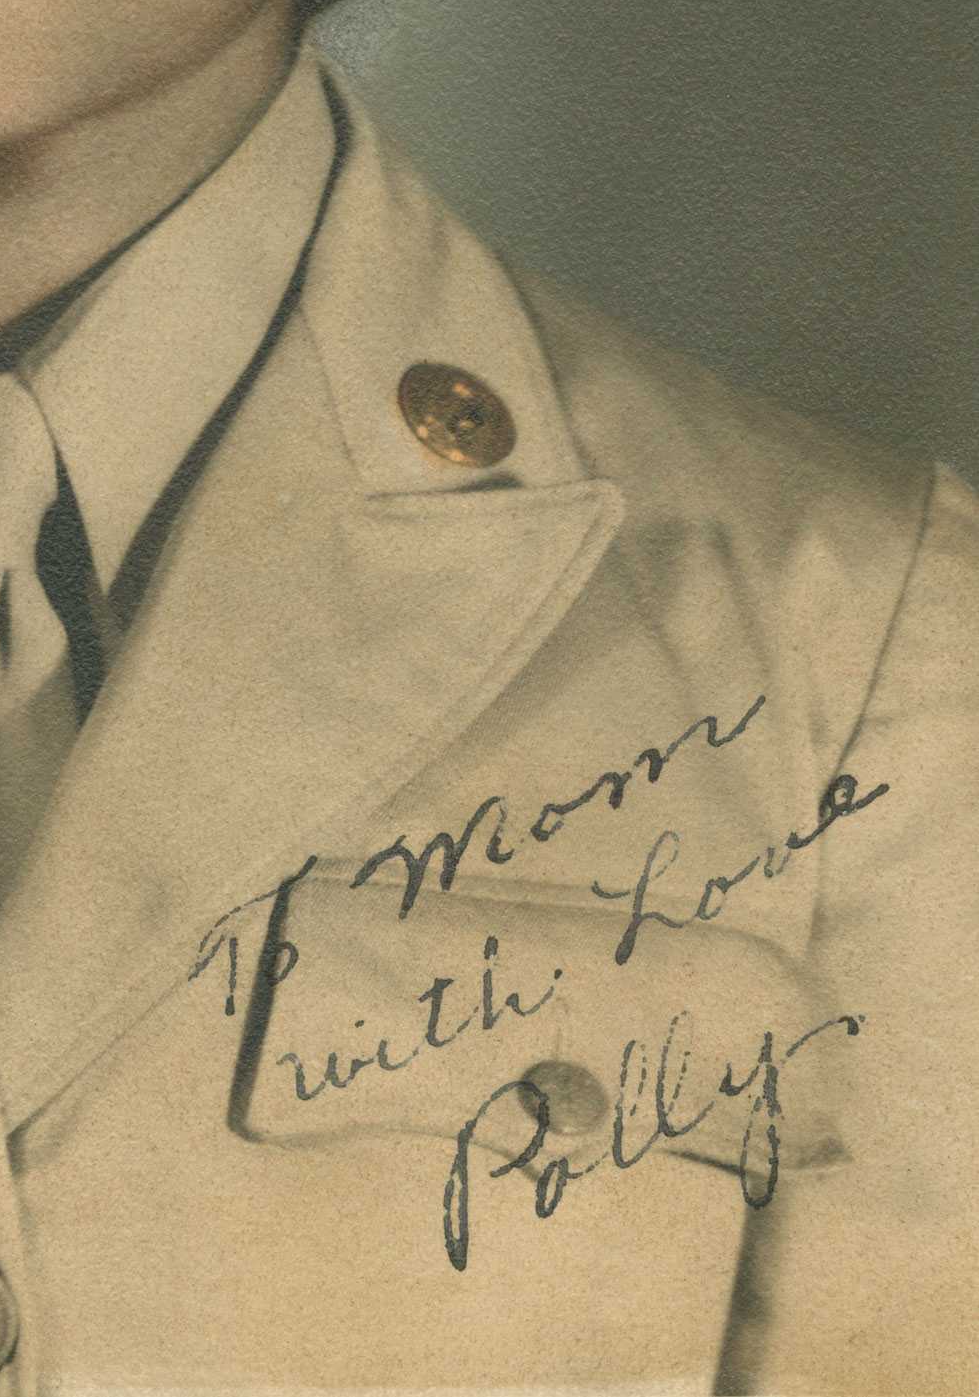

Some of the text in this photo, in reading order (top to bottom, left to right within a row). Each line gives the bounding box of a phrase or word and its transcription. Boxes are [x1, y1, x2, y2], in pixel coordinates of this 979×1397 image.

[187, 694, 767, 1017] To Mom
[277, 773, 890, 1101] with Love
[443, 1010, 865, 1272] Polly
